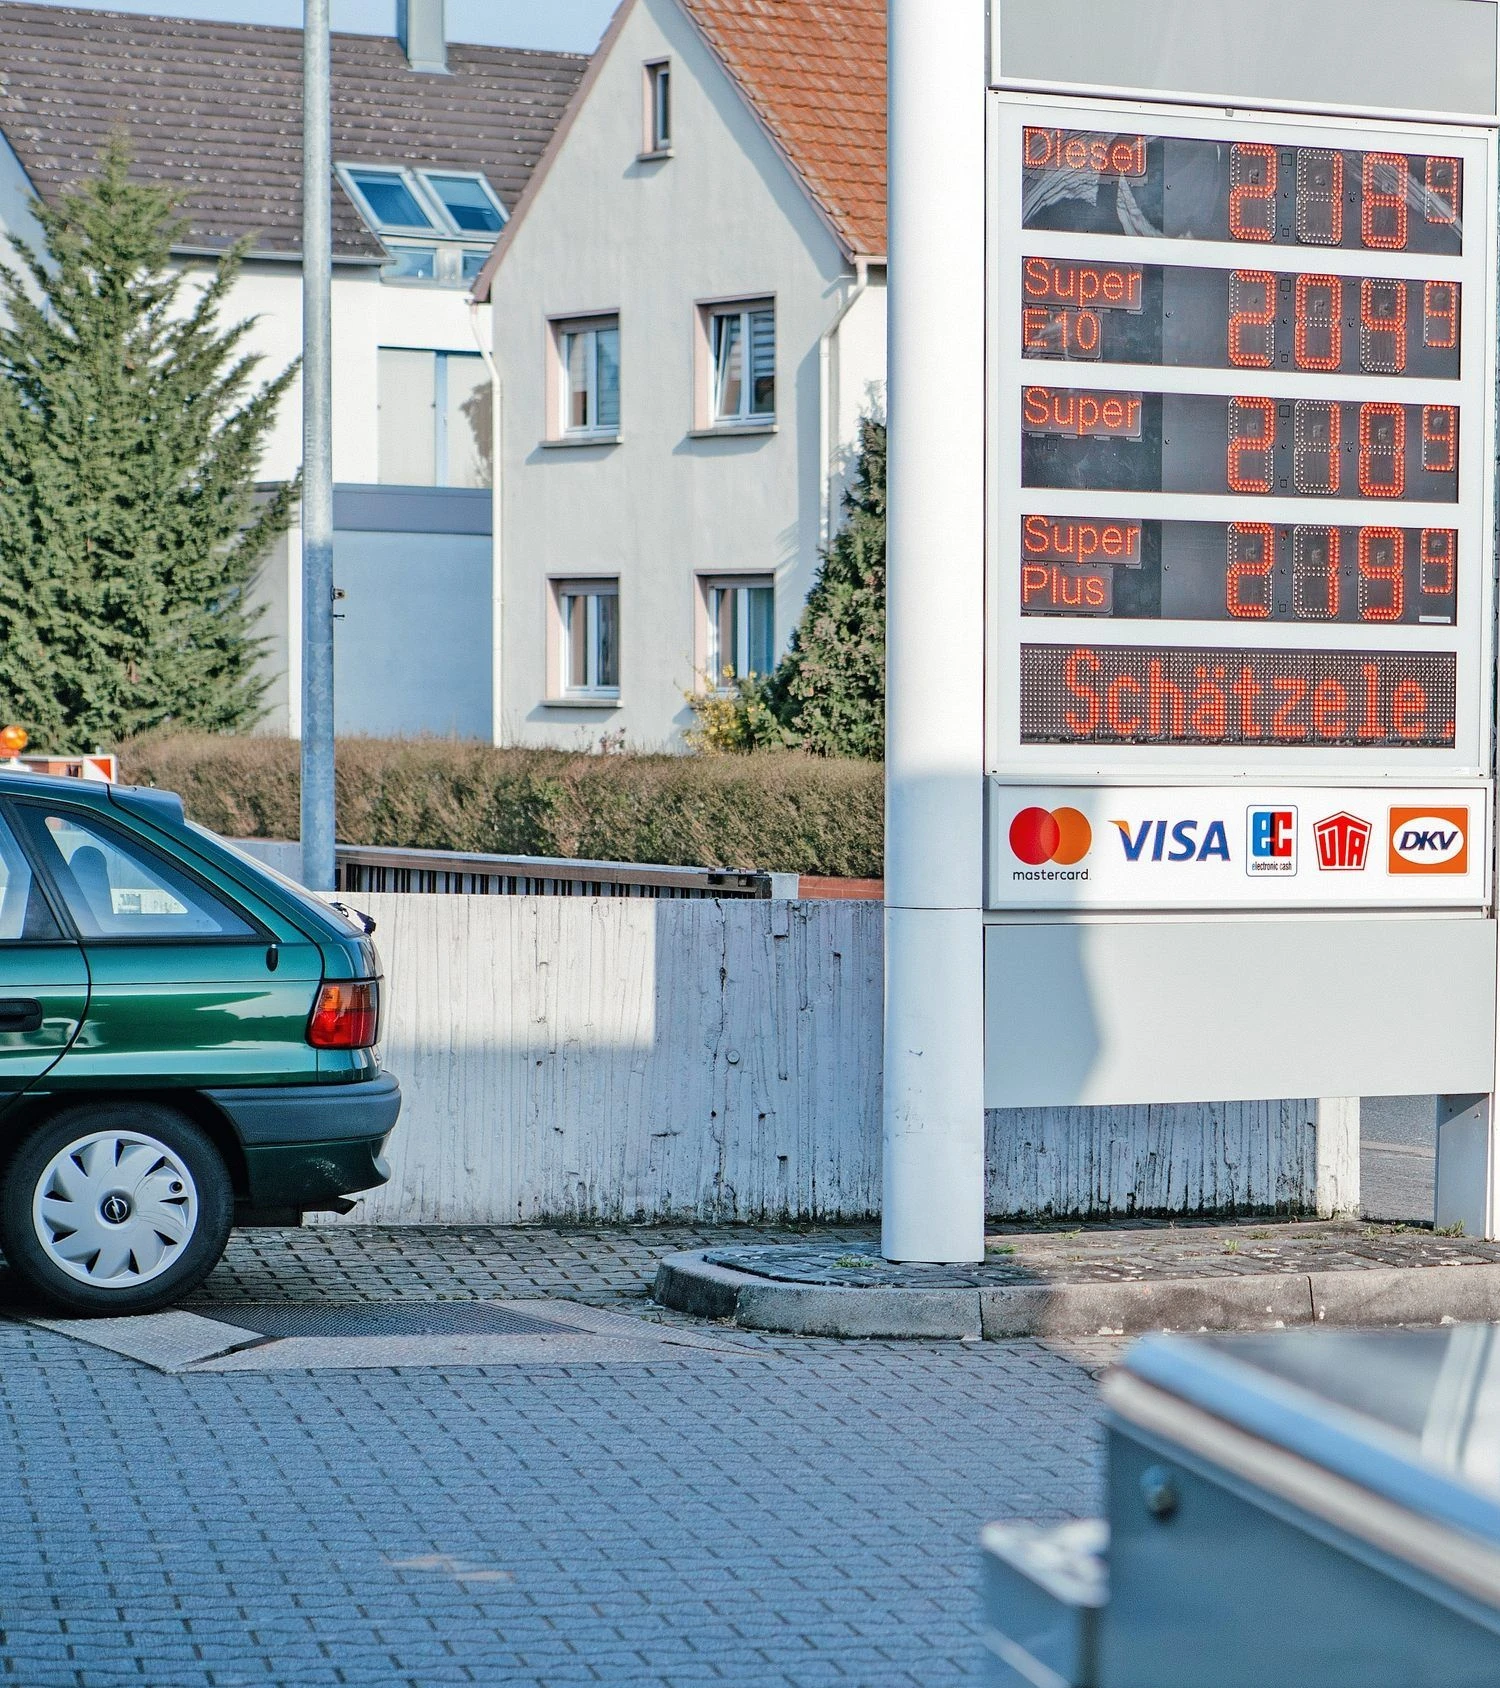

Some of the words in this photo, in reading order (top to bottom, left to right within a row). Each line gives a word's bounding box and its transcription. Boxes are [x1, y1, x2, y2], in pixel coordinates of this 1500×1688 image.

[1024, 127, 1144, 173] Diesel
[1025, 257, 1141, 307] Super
[1023, 309, 1099, 350] E10
[1024, 387, 1140, 435] Super
[1024, 515, 1140, 564] Super
[1022, 566, 1105, 606] Plus
[1108, 820, 1231, 862] VISA
[1317, 815, 1368, 867] UTA
[1399, 831, 1459, 851] DKV
[1012, 868, 1089, 881] mastercard
[1251, 861, 1278, 871] electronic
[1279, 861, 1292, 871] cash
